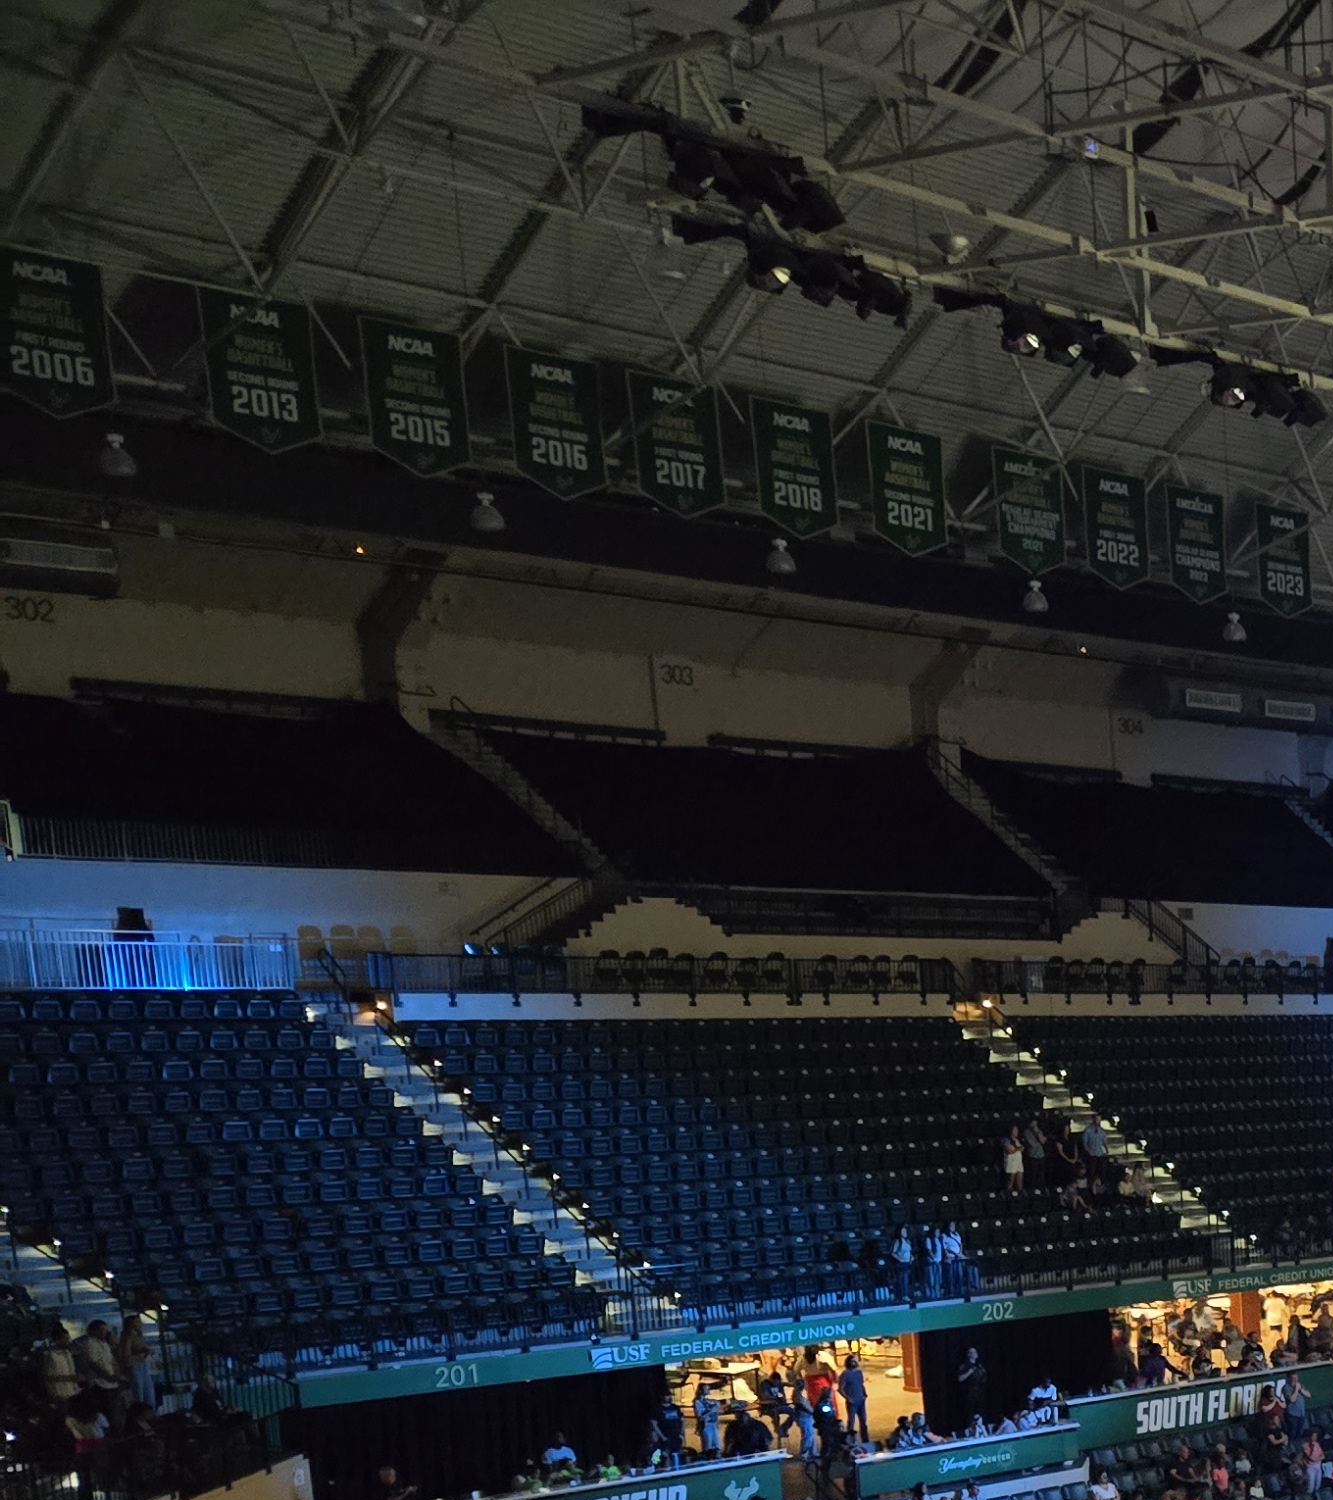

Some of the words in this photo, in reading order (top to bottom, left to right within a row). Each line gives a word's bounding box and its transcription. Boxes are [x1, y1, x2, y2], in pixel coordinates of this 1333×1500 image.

[12, 260, 67, 285] NCAA
[388, 335, 434, 358] NCAA
[9, 344, 95, 387] 2006
[530, 363, 574, 385] NCAA
[231, 385, 298, 423] 2013
[389, 412, 450, 447] 2015
[773, 412, 810, 432] NCAA
[531, 436, 588, 471] 2016
[887, 435, 924, 454] NCAA
[655, 459, 706, 490] 2017
[773, 481, 822, 513] 2018
[1099, 479, 1129, 497] NCAA
[886, 500, 933, 532] 2021
[1270, 515, 1295, 531] NCAA
[1097, 540, 1139, 567] 2022
[1267, 571, 1304, 597] 2023
[4, 598, 55, 624] 302
[660, 663, 694, 686] 303
[1117, 717, 1144, 736] 304
[1188, 1279, 1213, 1295] USF
[1218, 1276, 1266, 1291] FEDERAL
[1270, 1270, 1307, 1285] CREDIT
[982, 1301, 1014, 1322] 202
[614, 1343, 650, 1365] USF
[661, 1337, 733, 1359] FEDERAL
[738, 1329, 791, 1350] CREDIT
[435, 1364, 478, 1388] 201
[1136, 1392, 1204, 1435] SOUTH
